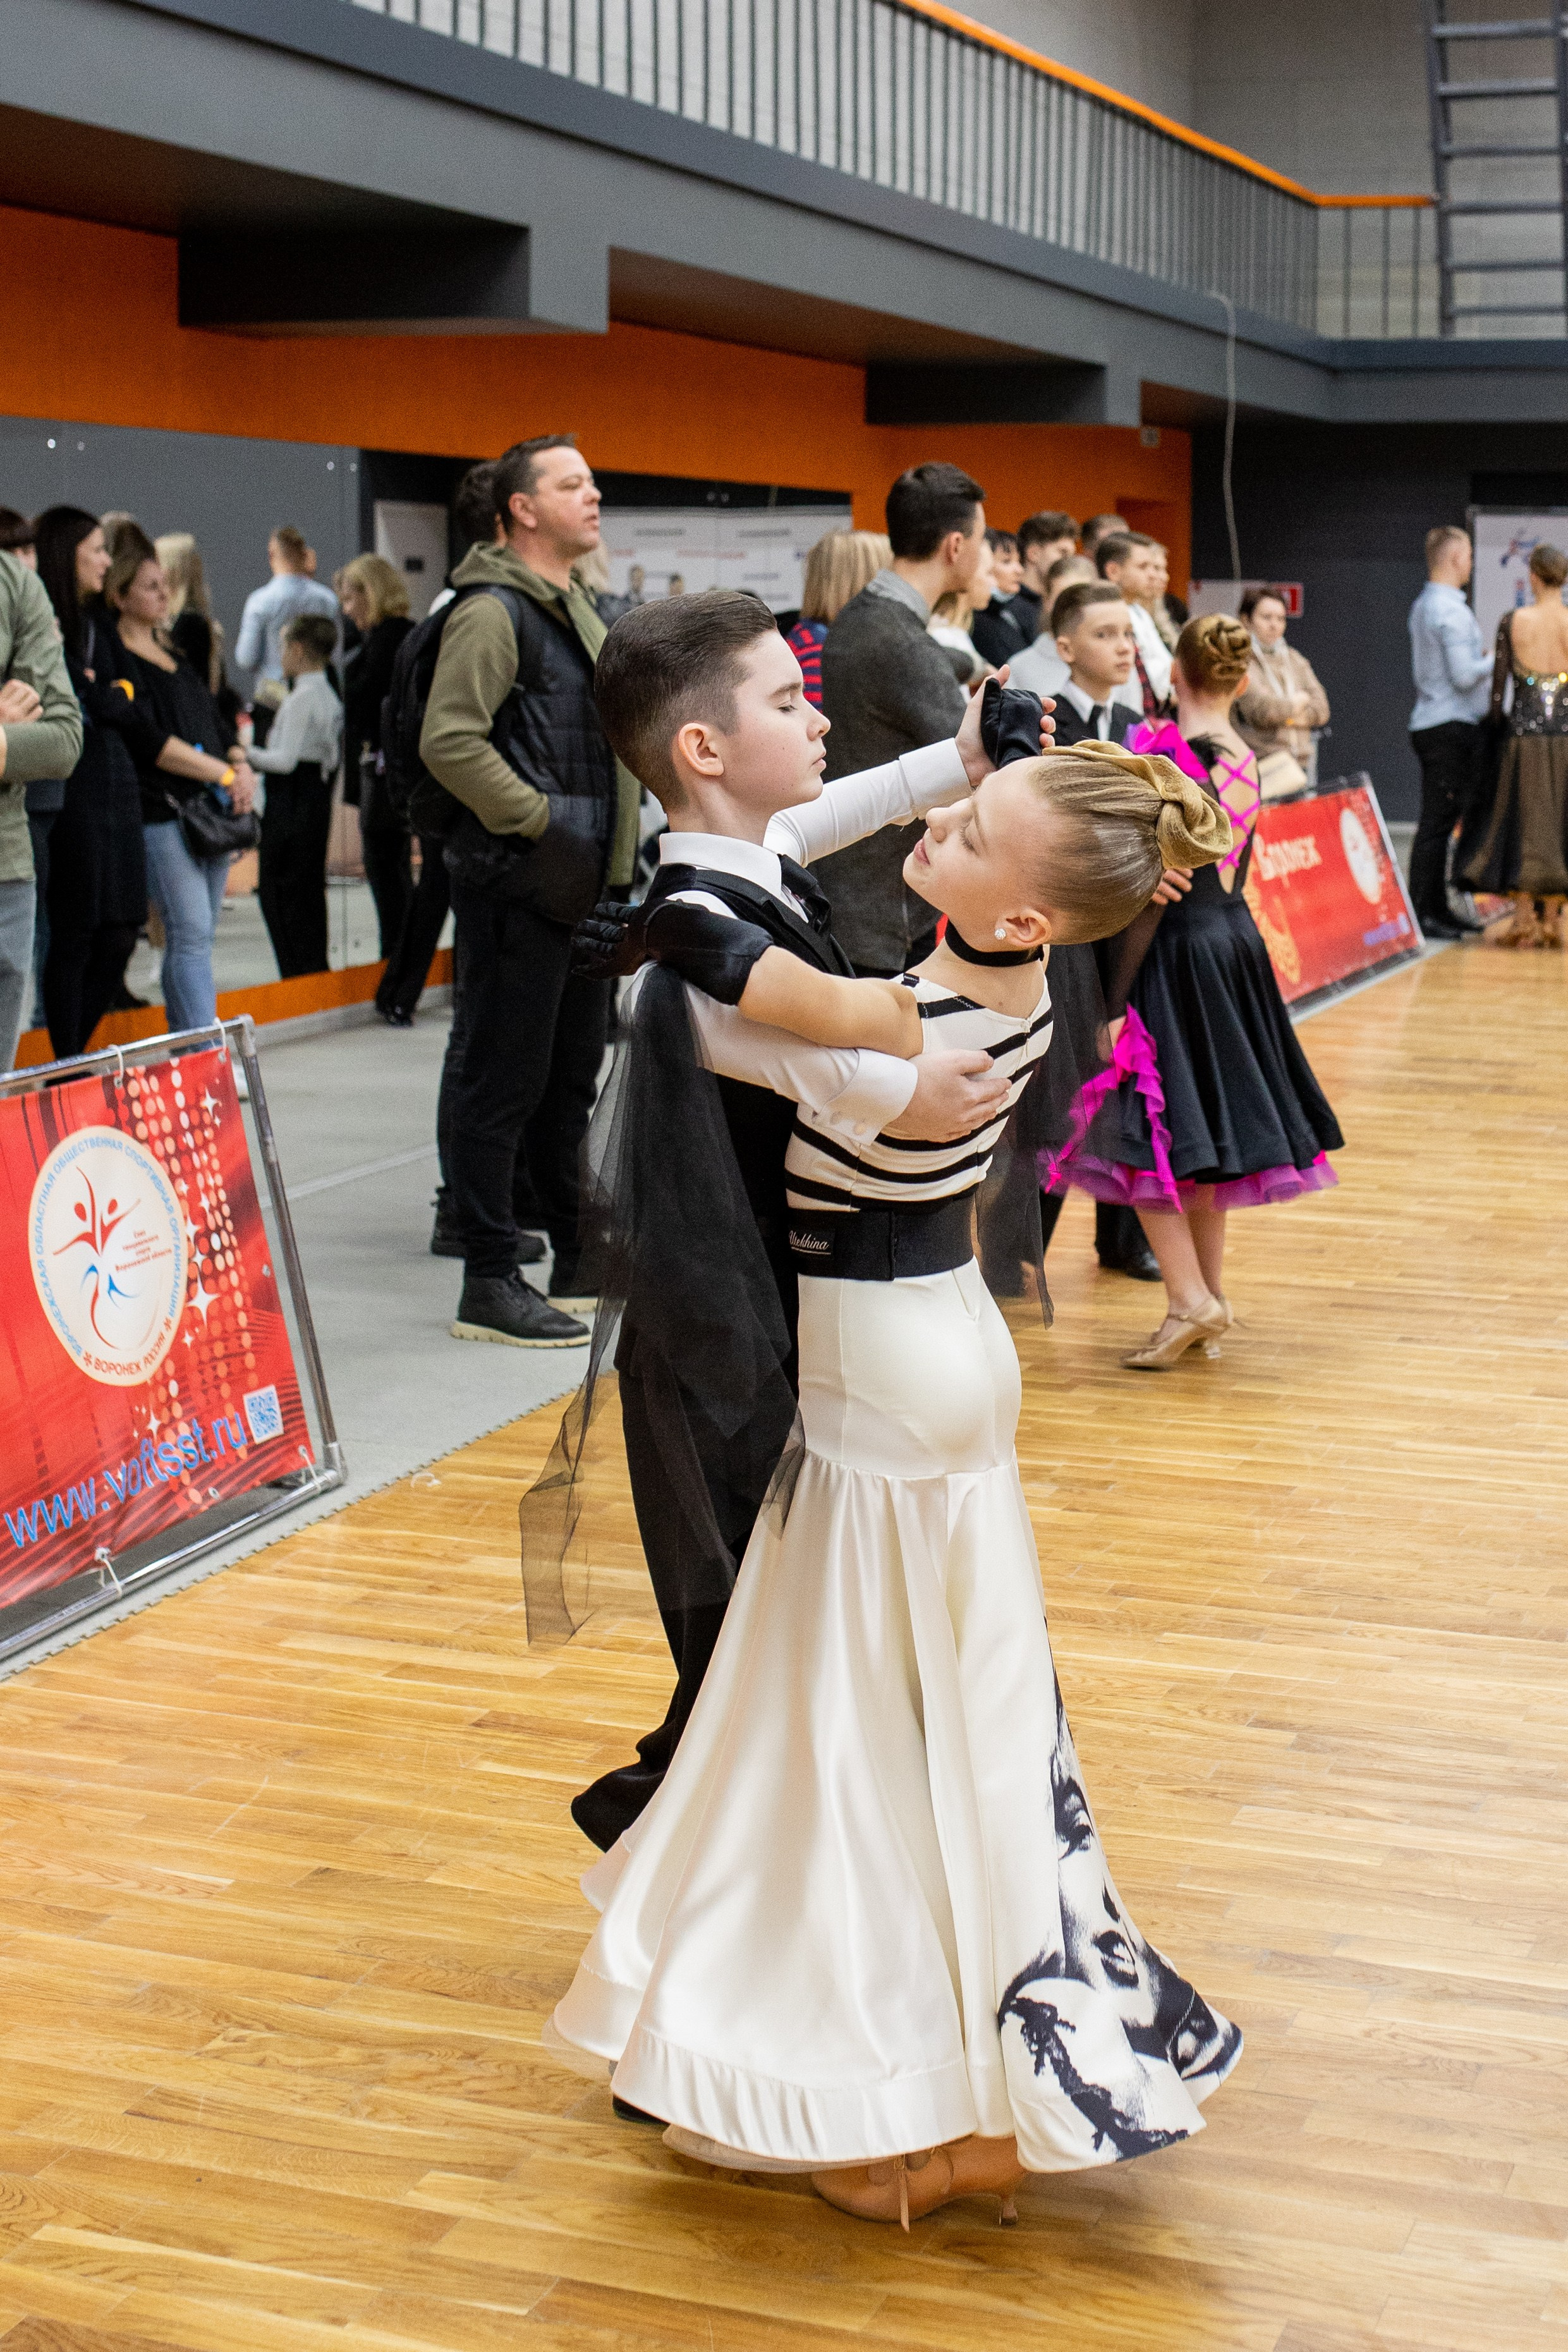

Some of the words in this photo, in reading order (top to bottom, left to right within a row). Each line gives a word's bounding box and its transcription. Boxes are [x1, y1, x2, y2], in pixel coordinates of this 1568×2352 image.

[35, 1172, 56, 1255] ОБЛАСТНАЯ
[52, 1136, 123, 1175] ОБЩЕСТВЕННАЯ
[4, 1412, 248, 1548] www.voftsst.ru
